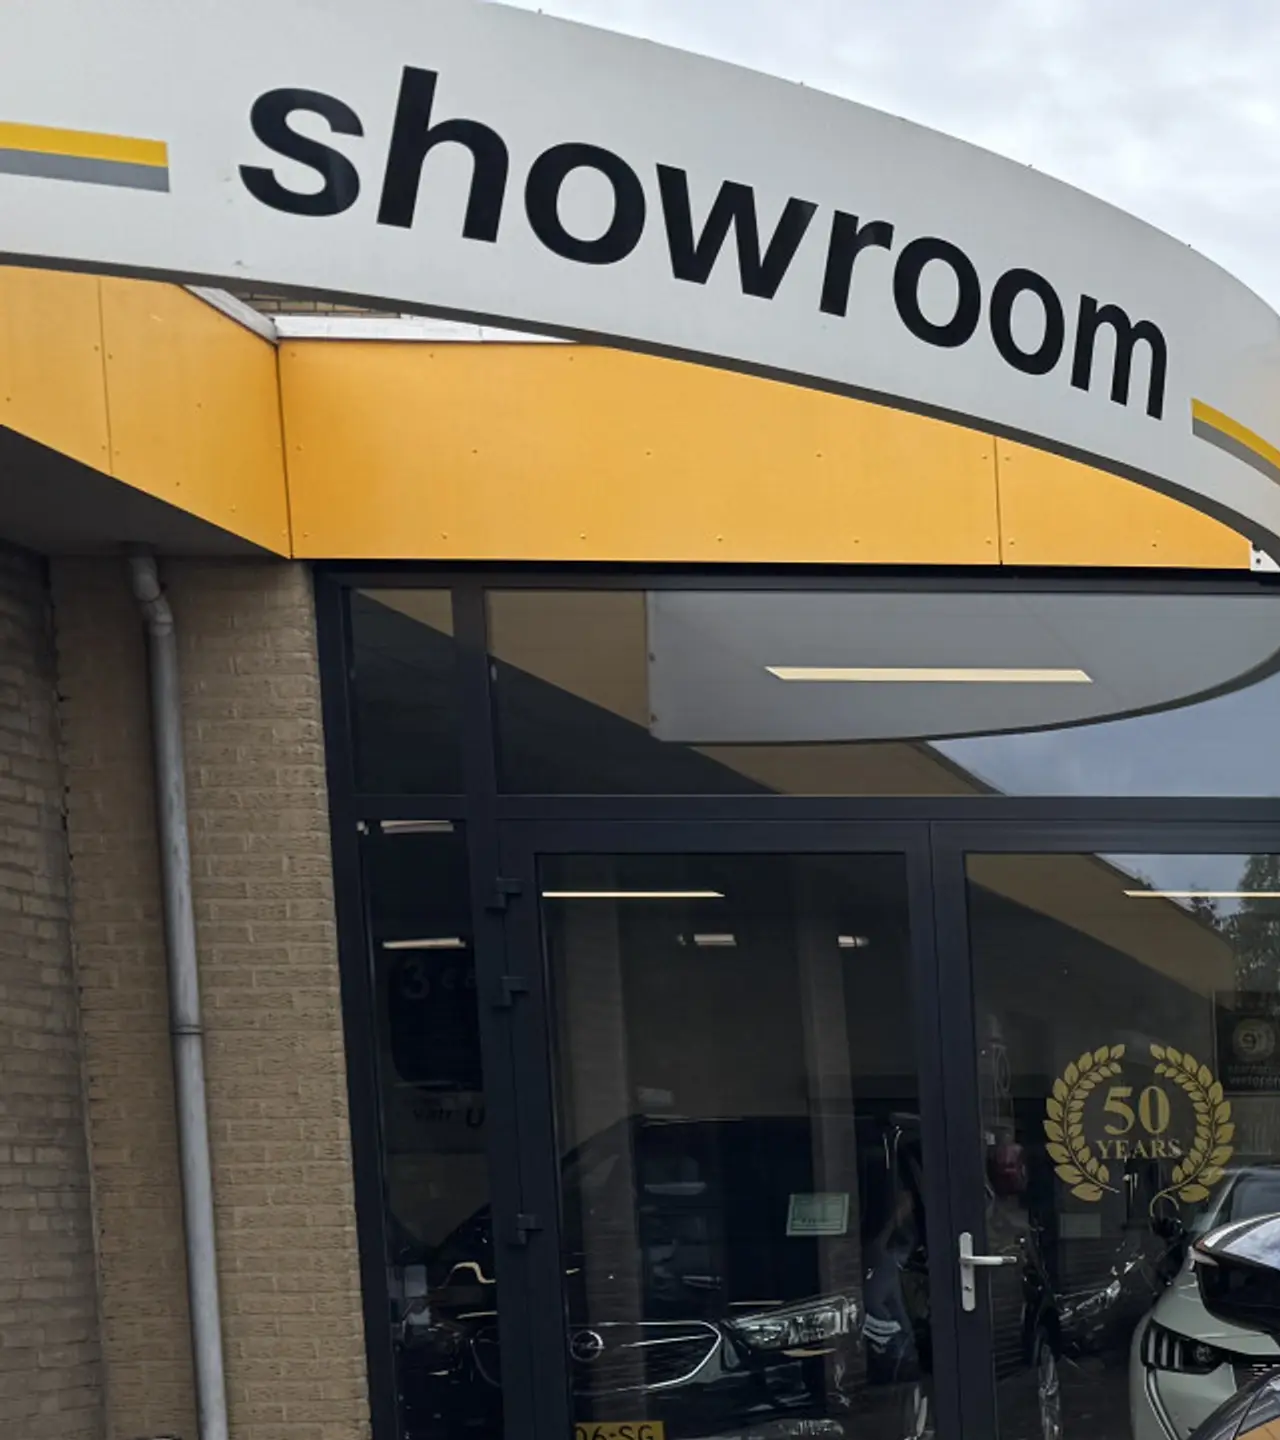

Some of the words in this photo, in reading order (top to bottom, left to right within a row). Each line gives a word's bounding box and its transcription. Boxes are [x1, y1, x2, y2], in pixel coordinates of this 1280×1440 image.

[238, 66, 1169, 421] showroom
[1103, 1085, 1170, 1135] 50
[1096, 1139, 1182, 1160] YEARS
